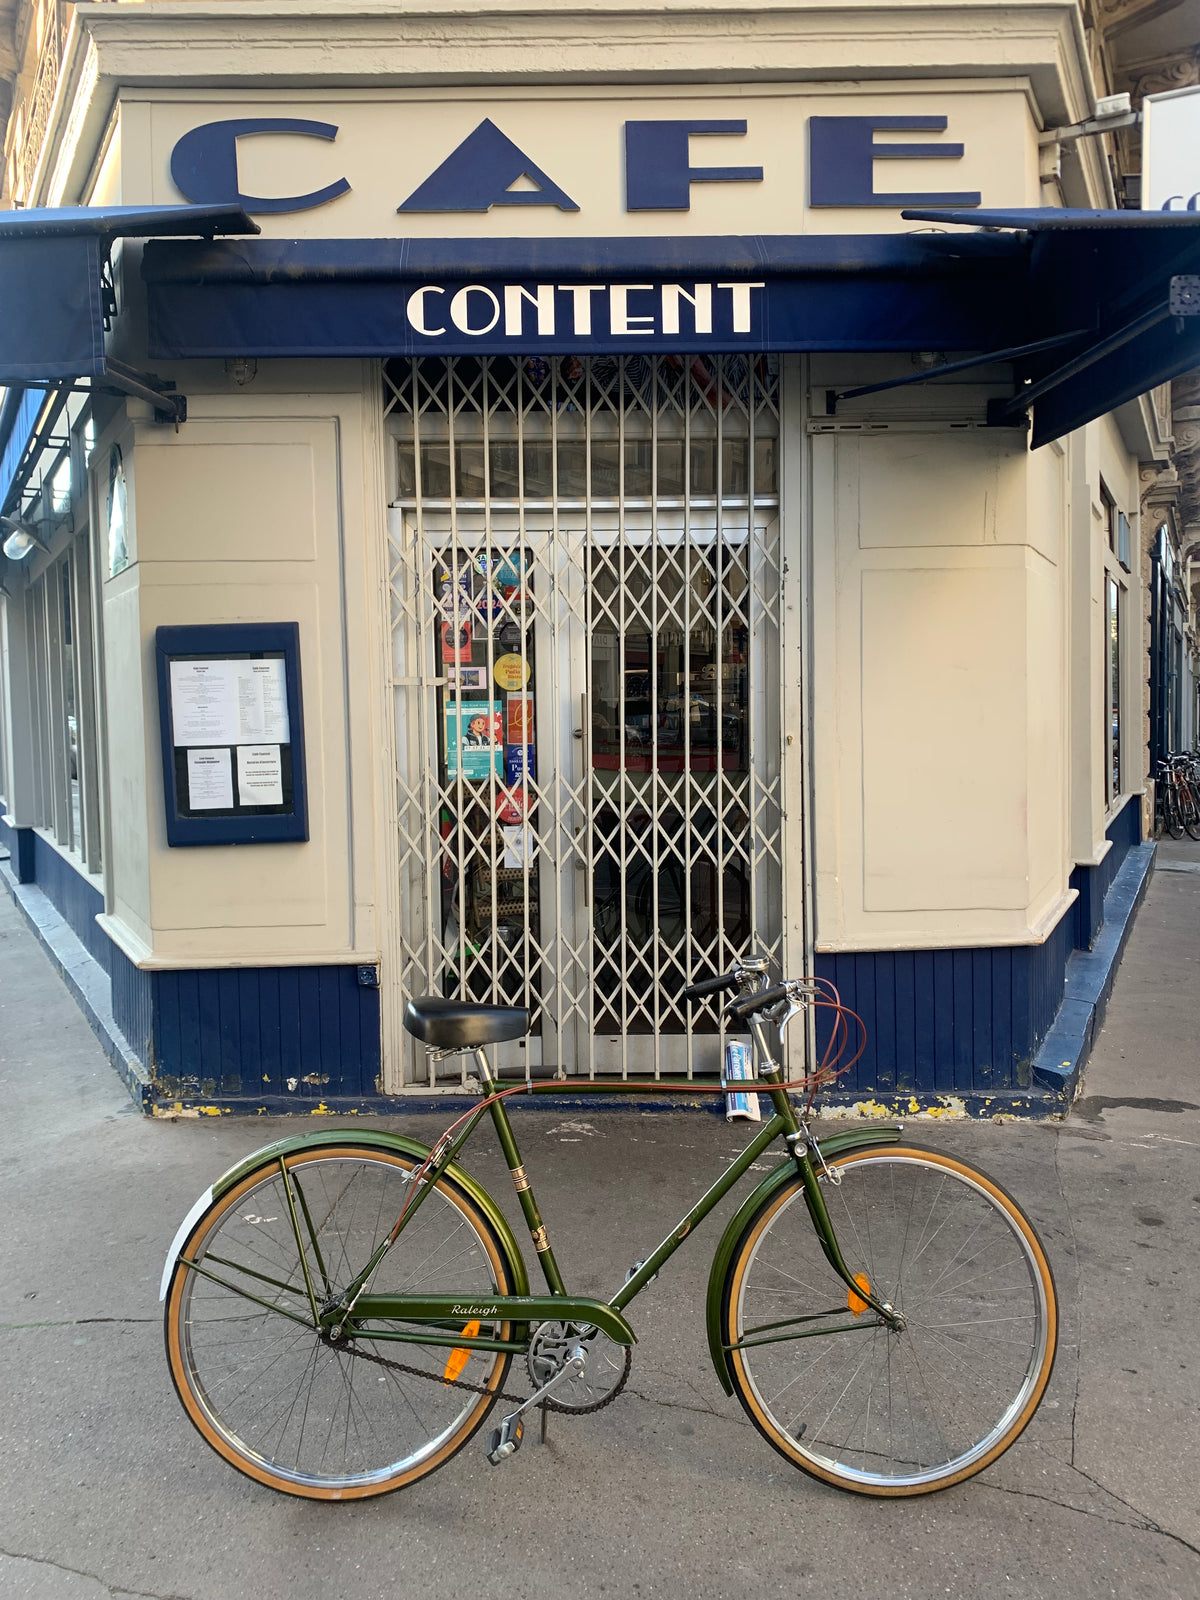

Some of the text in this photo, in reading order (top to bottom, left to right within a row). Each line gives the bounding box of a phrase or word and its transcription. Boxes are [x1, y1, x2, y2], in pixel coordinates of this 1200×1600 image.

[171, 115, 981, 214] CAFE
[406, 282, 766, 337] CONTENT
[451, 1304, 498, 1316] Raleigh
